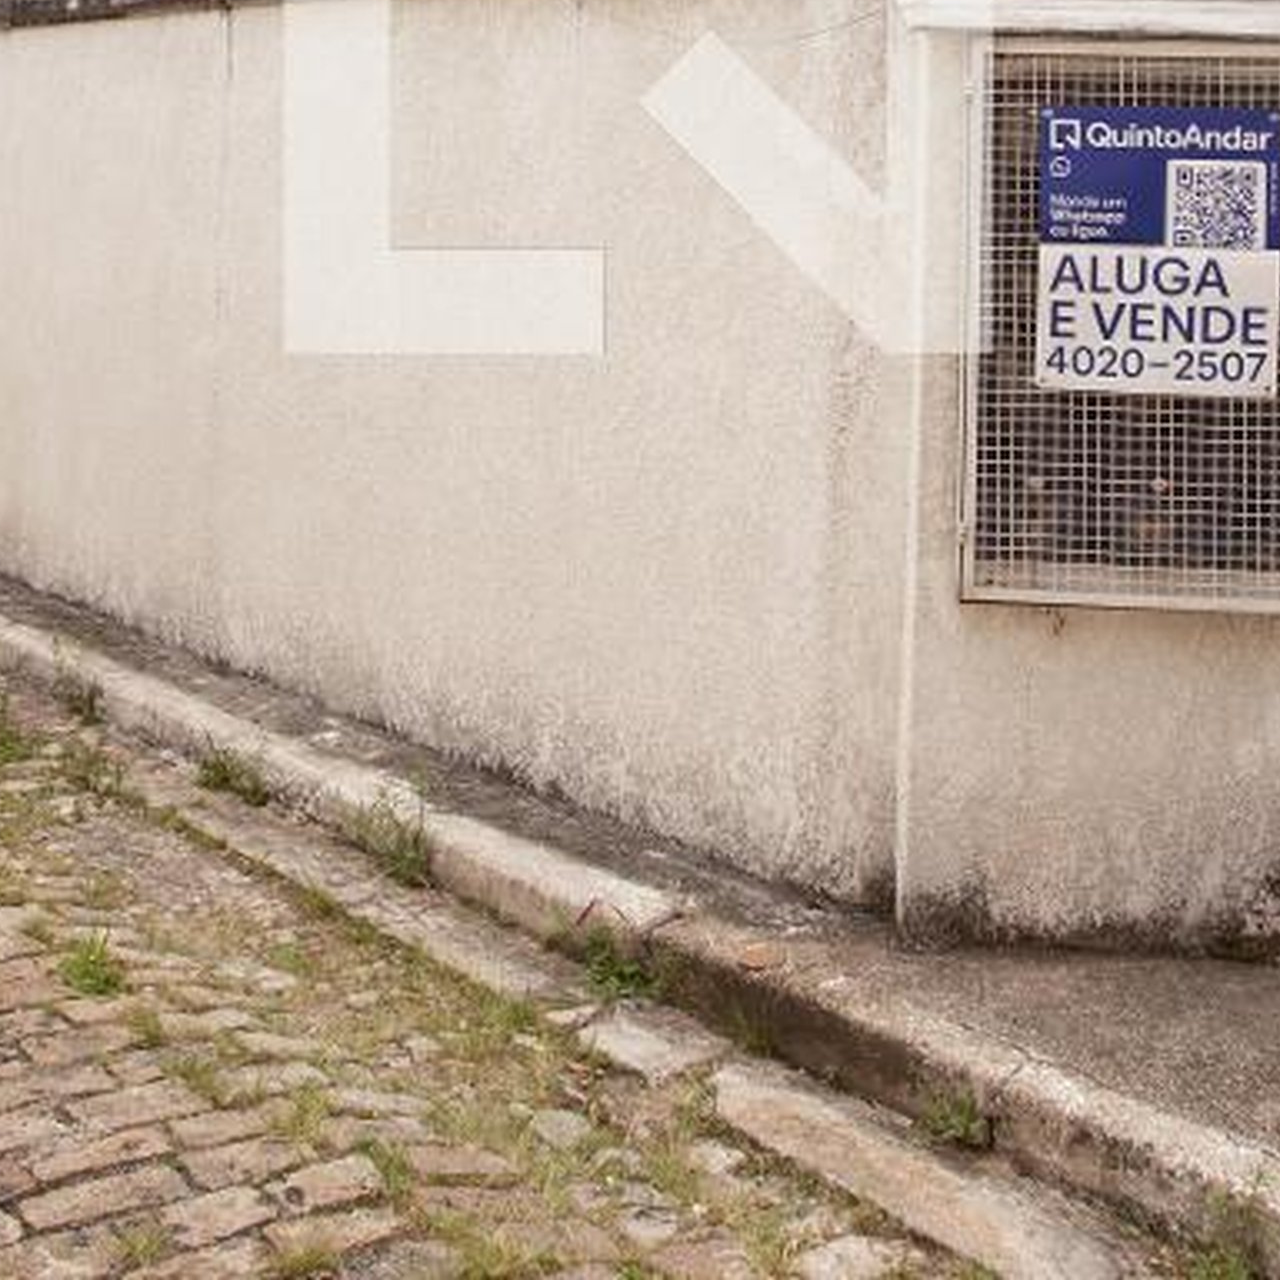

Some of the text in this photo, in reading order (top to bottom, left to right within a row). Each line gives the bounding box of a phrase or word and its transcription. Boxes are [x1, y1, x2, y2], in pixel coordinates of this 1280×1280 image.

[1085, 122, 1273, 151] QuintoAndar
[1049, 254, 1230, 297] ALUGA
[1050, 300, 1268, 346] E VENDE
[1046, 346, 1268, 382] 4020-2507
